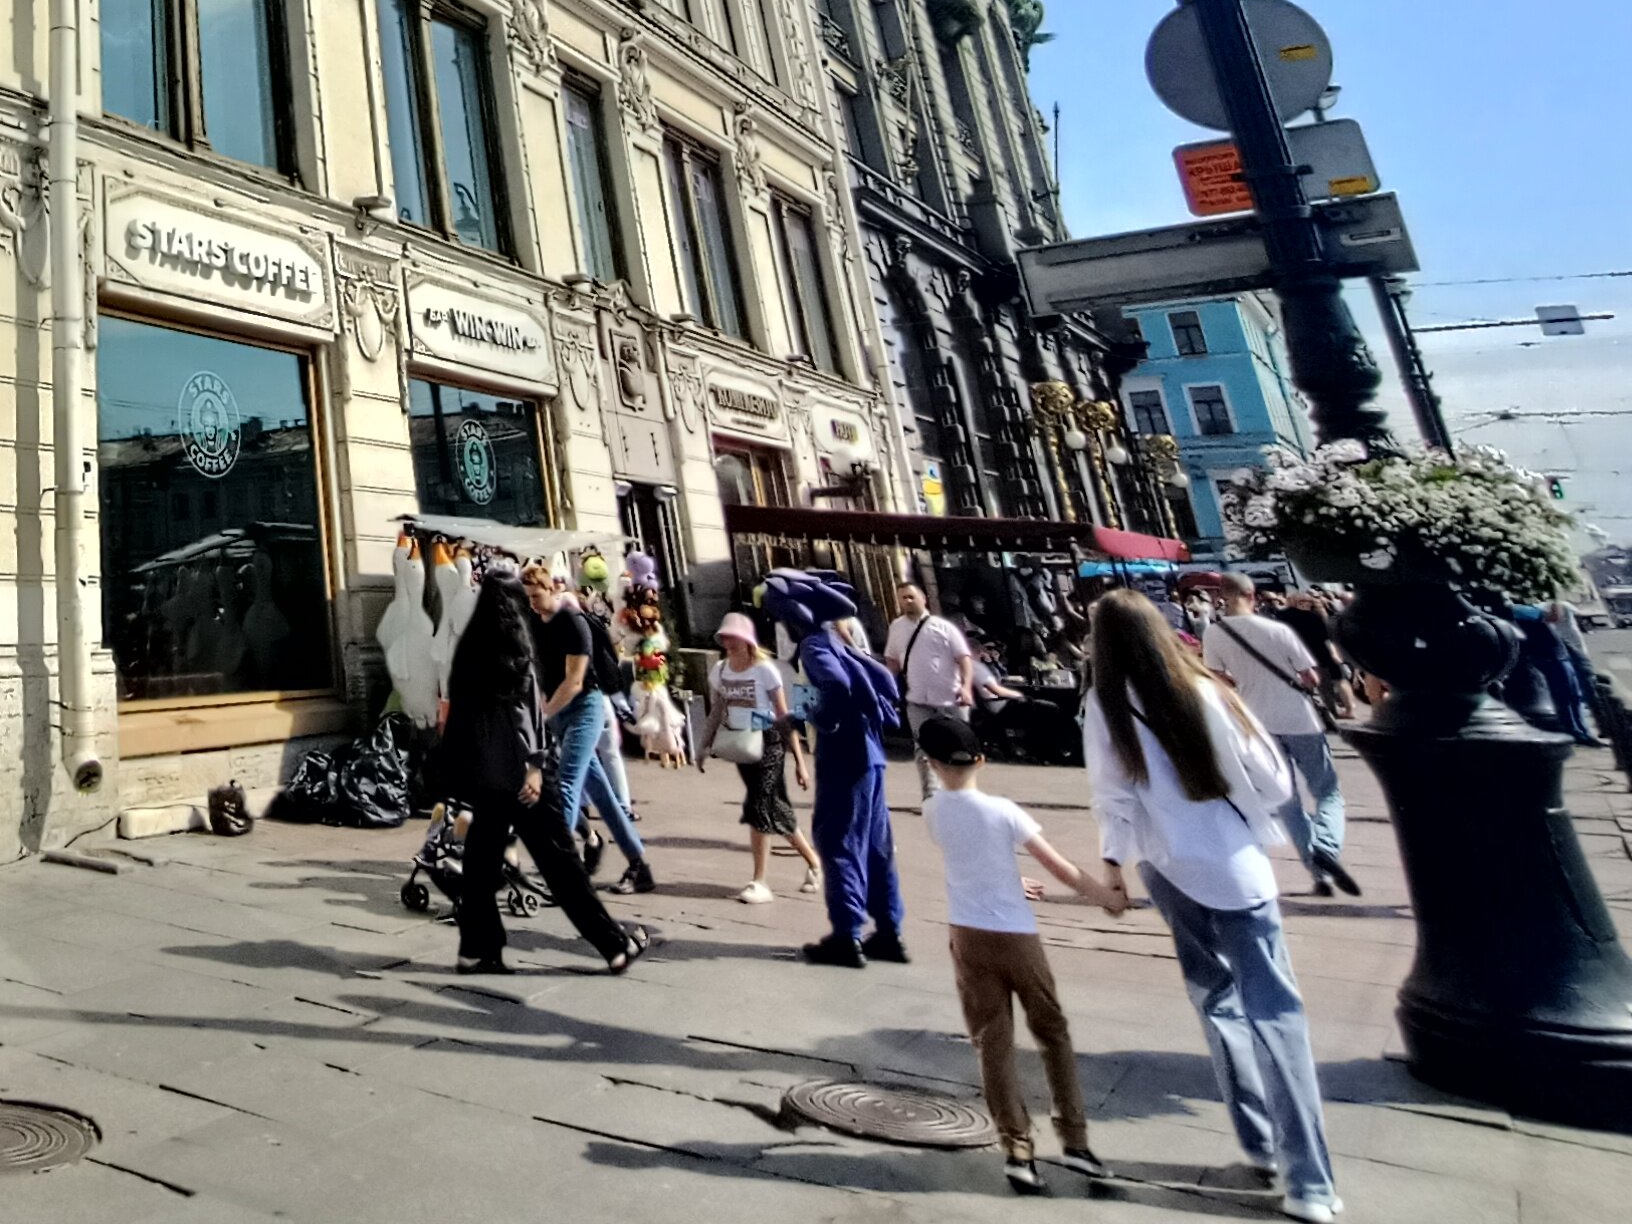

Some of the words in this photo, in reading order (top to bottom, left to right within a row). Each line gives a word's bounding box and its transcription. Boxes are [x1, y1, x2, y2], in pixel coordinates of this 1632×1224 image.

[126, 219, 228, 269] STARS
[188, 375, 229, 405] STARS
[190, 443, 233, 473] COFFEE
